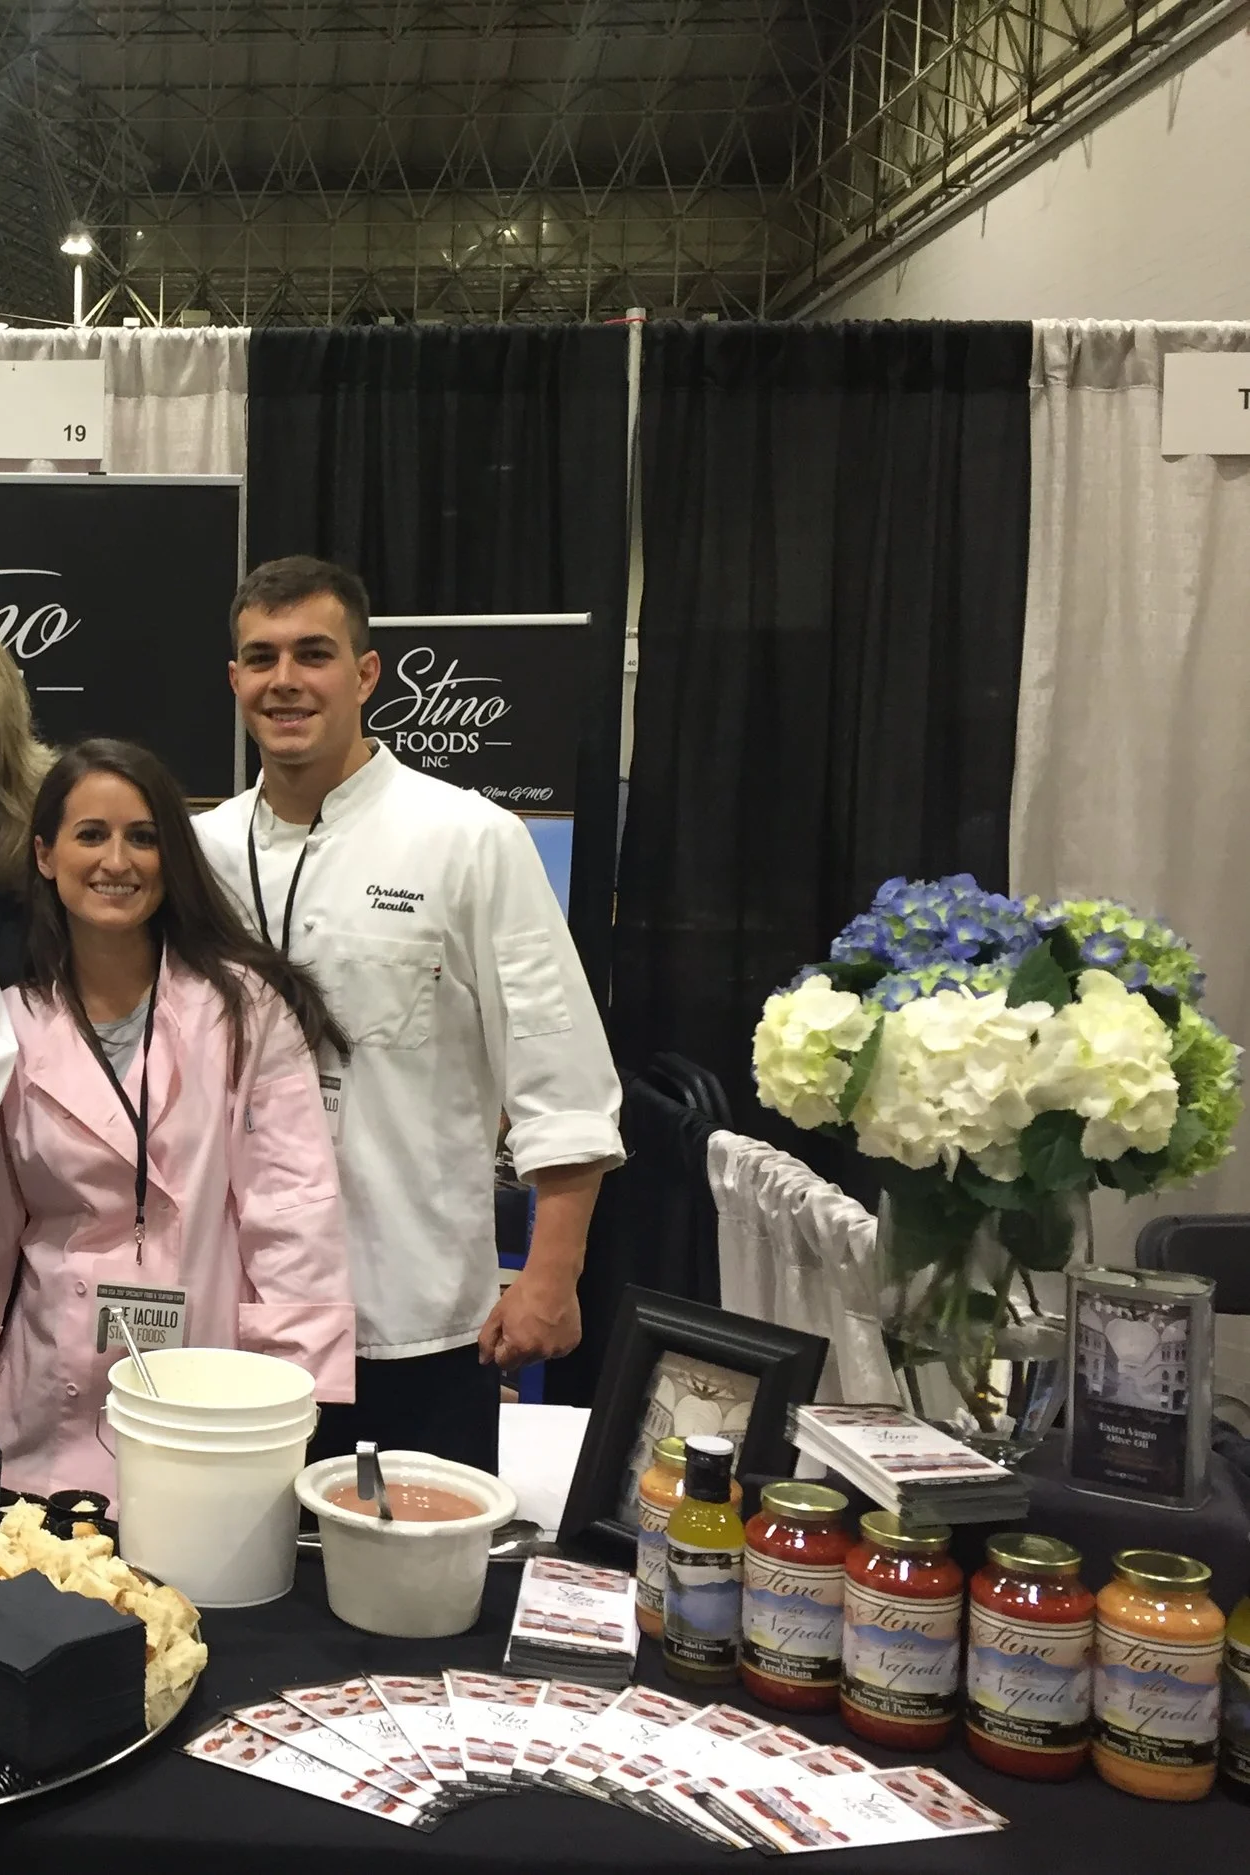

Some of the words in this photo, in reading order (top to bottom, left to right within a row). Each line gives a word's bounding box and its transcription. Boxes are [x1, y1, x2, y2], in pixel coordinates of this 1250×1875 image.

[63, 424, 87, 442] 19
[367, 646, 512, 731] Stino
[395, 731, 480, 754] FOODS
[482, 785, 508, 799] Non
[508, 786, 554, 801] GMO
[366, 885, 424, 901] Christian
[134, 1307, 179, 1328] IACULLO
[109, 1325, 134, 1341] STO
[137, 1327, 166, 1344] FOODS
[749, 1569, 824, 1598] Stino
[857, 1604, 935, 1633] Stino
[751, 1614, 835, 1651] Napoli
[976, 1626, 1055, 1657] Stino
[856, 1651, 945, 1688] Napoli
[1104, 1643, 1189, 1675] Stino
[880, 1701, 890, 1712] di
